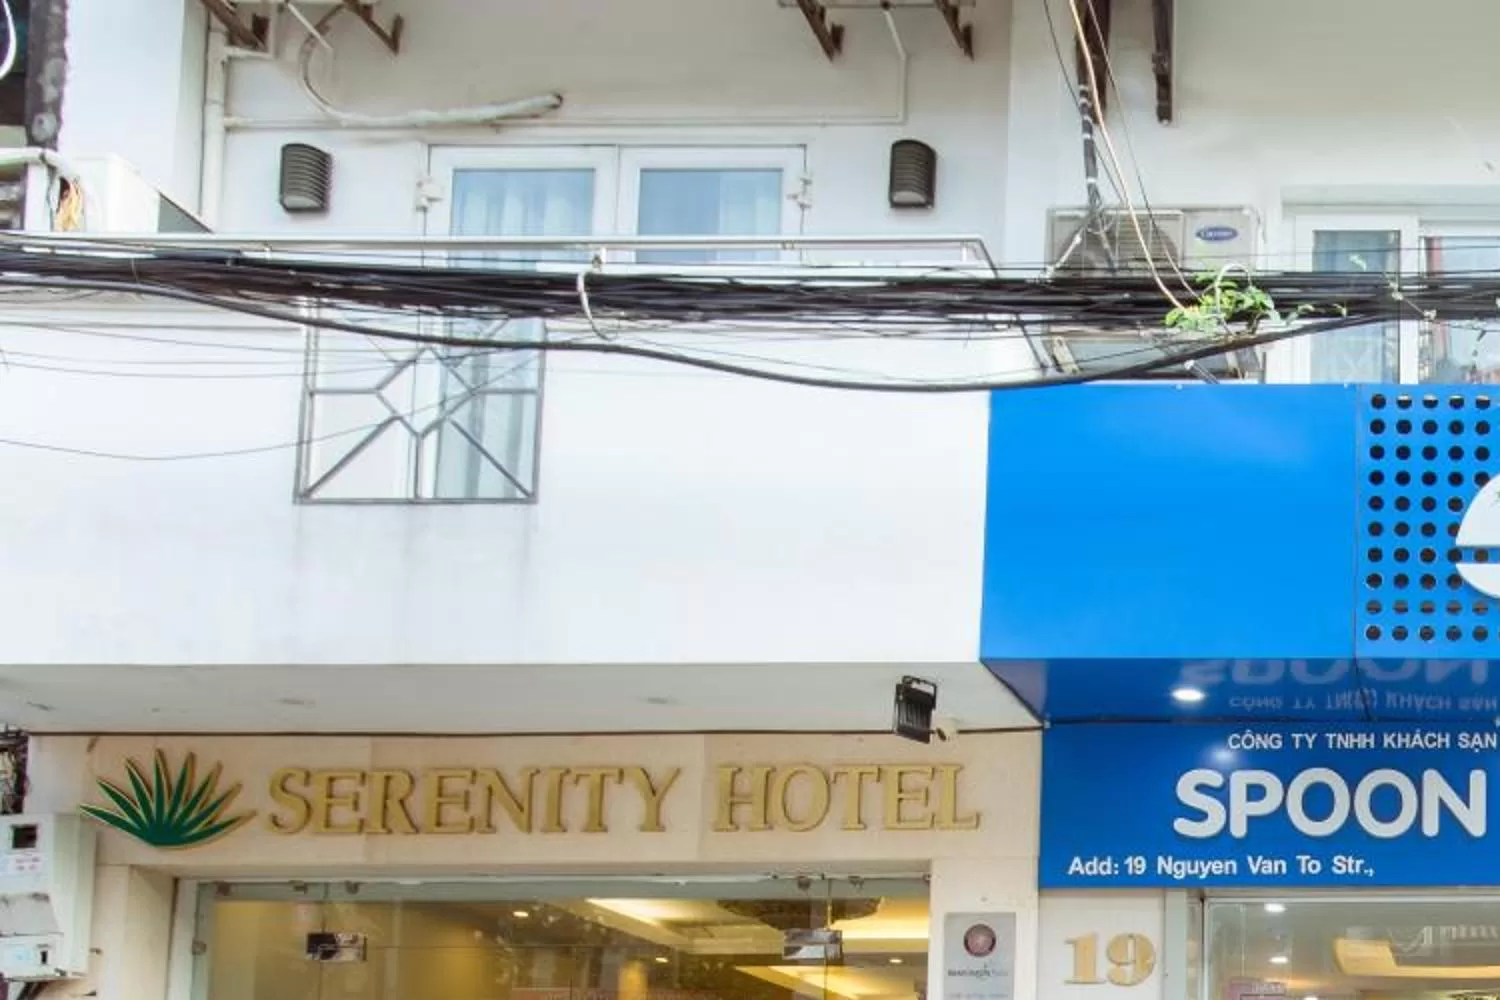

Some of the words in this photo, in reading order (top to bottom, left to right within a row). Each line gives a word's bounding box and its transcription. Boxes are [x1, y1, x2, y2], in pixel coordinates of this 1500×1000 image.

[1228, 729, 1283, 750] CÔNG
[1292, 733, 1317, 749] TY
[1326, 733, 1375, 749] TNHH
[1384, 729, 1450, 749] KHÁCH
[1458, 732, 1497, 753] SẠN
[268, 764, 684, 836] SERENITY
[712, 762, 983, 832] HOTEL
[1173, 766, 1487, 839] SPOON
[1067, 855, 1120, 876] Add:
[1123, 856, 1147, 875] 19
[1157, 855, 1238, 879] Nguyen
[1247, 856, 1288, 875] Van
[1296, 855, 1322, 875] To
[1063, 932, 1157, 987] 19
